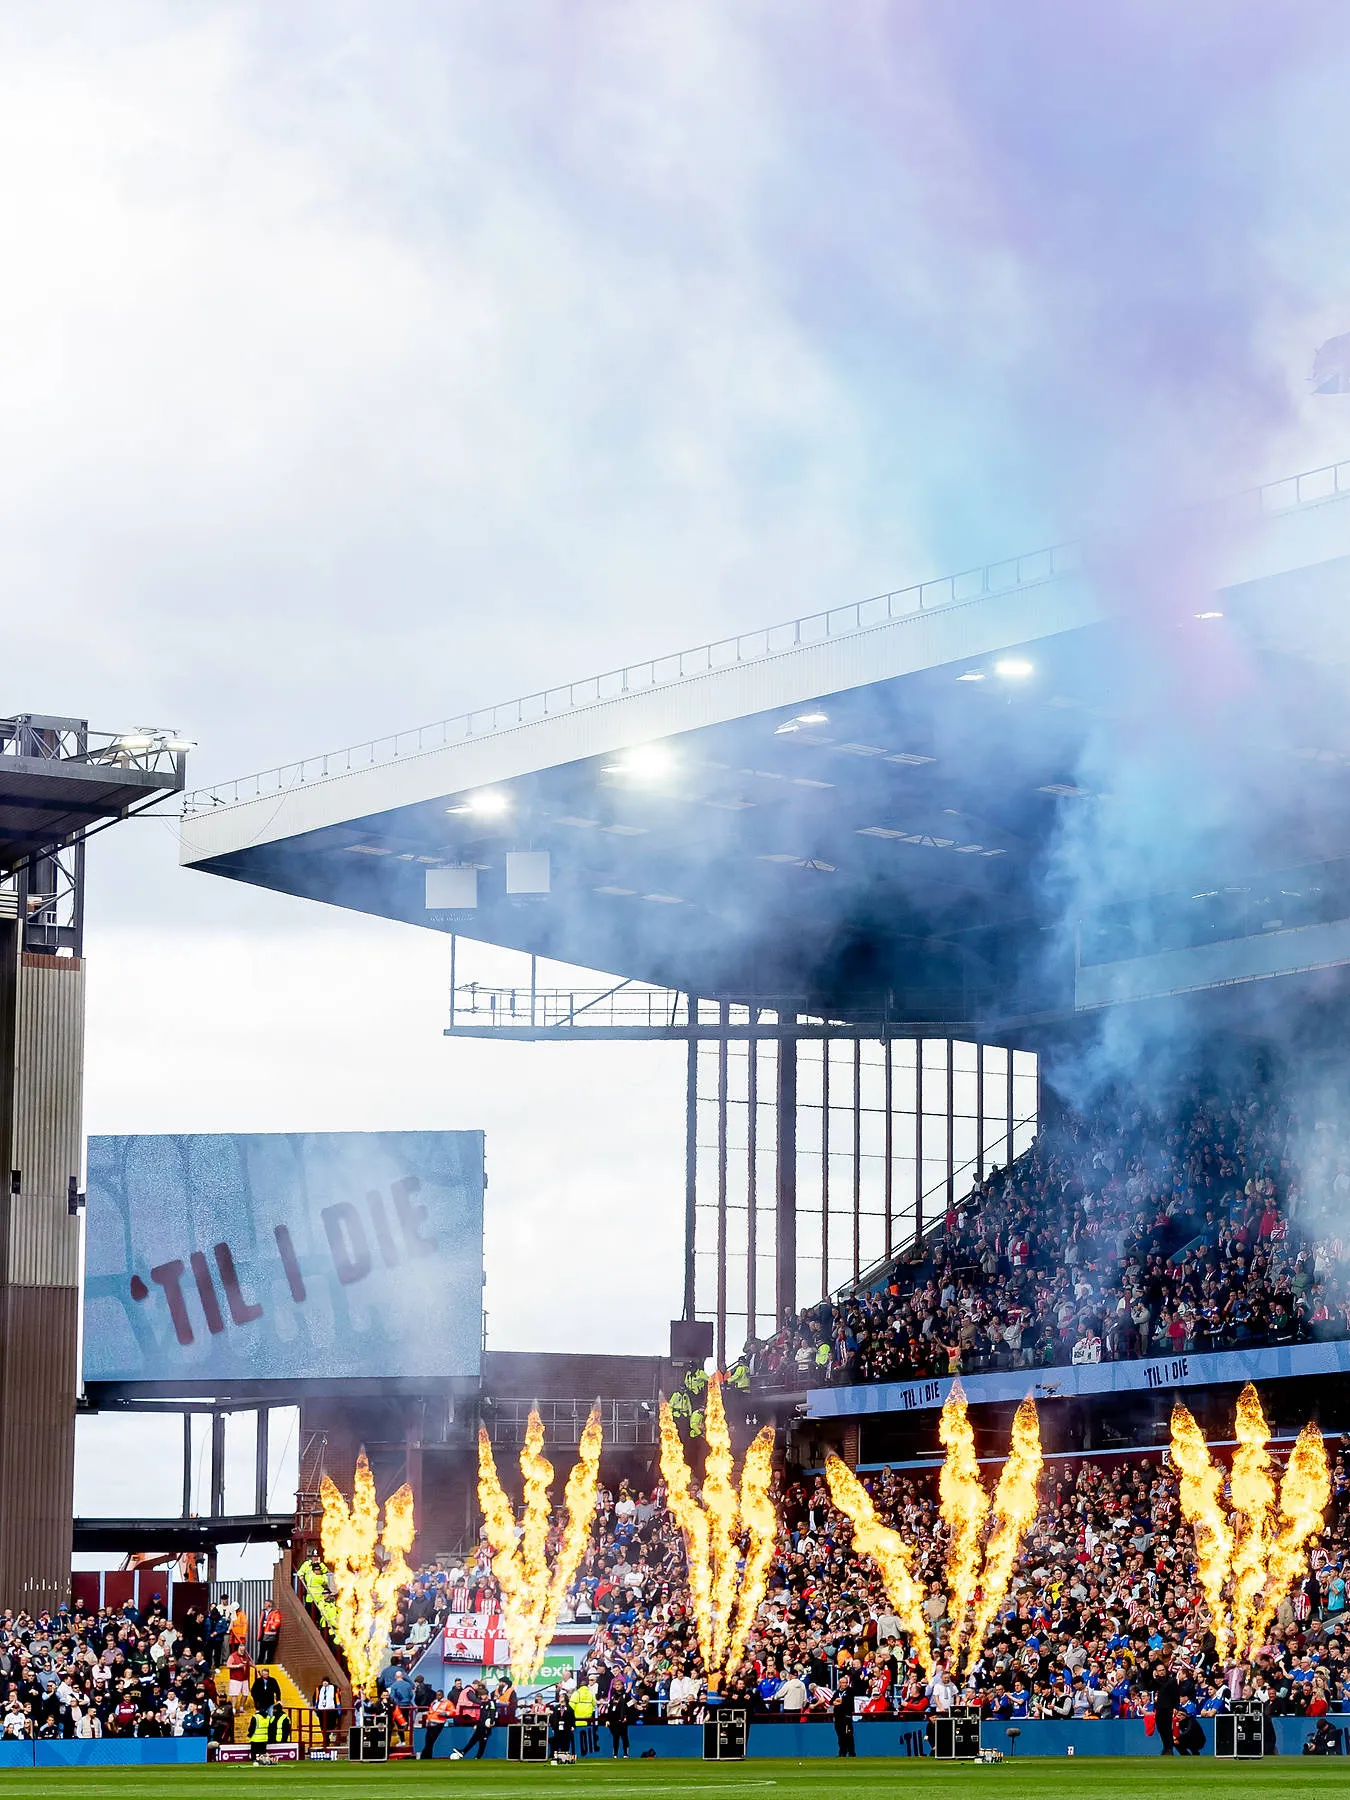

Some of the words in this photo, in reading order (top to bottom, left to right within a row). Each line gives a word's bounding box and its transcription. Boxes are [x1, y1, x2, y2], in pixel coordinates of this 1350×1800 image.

[130, 1242, 264, 1346] 'TIL
[274, 1224, 307, 1304] I
[321, 1175, 438, 1287] DIE
[1143, 1365, 1163, 1388] 'TIL
[1164, 1364, 1169, 1383] I
[1171, 1357, 1189, 1380] DIE
[899, 1388, 918, 1410] 'TIL
[918, 1386, 923, 1405] I
[925, 1380, 940, 1402] DIE
[447, 1627, 506, 1639] FERRYH
[579, 1724, 601, 1757] DIE
